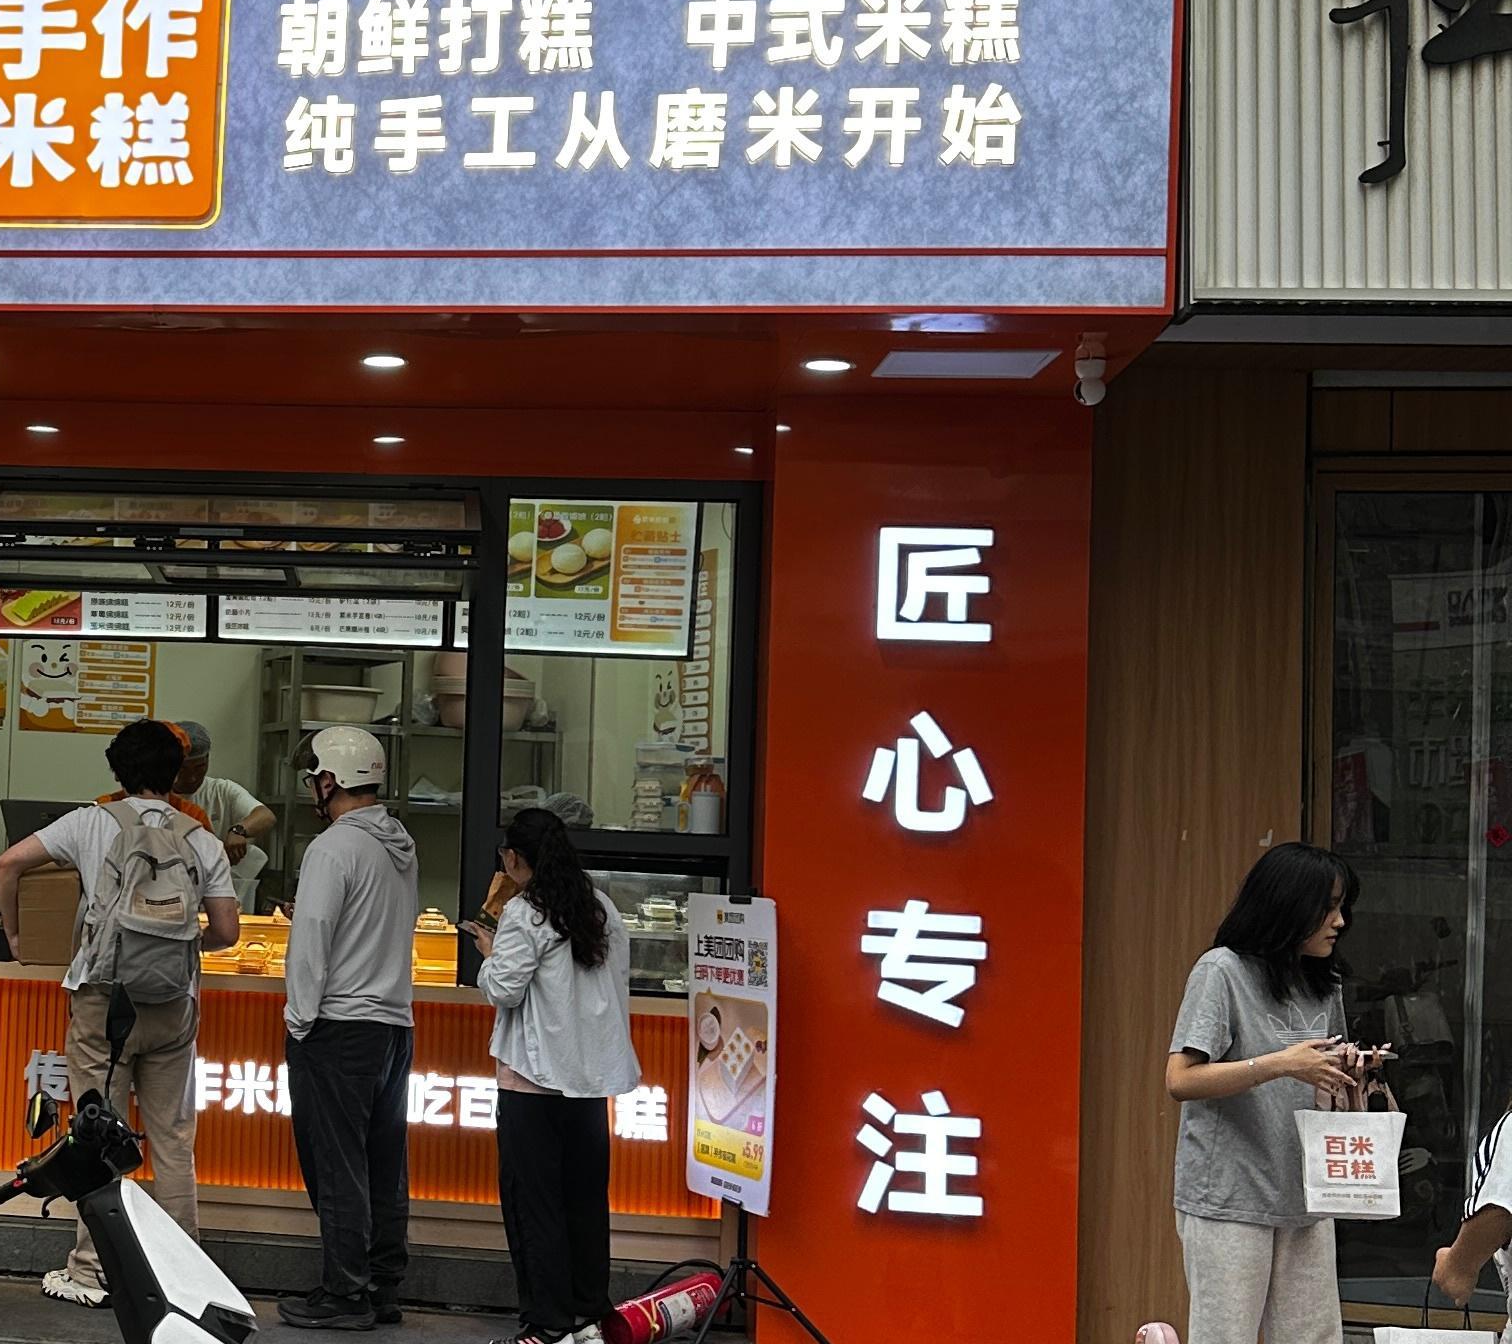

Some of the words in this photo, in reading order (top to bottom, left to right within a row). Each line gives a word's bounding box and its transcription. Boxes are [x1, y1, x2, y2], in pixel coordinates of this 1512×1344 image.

[283, 82, 1024, 175] 纯手工从磨米开始
[856, 525, 995, 1219] 匠心专注
[694, 933, 745, 963] 上美团团购
[1324, 1135, 1374, 1156] 百米
[1325, 1158, 1377, 1180] 百糕
